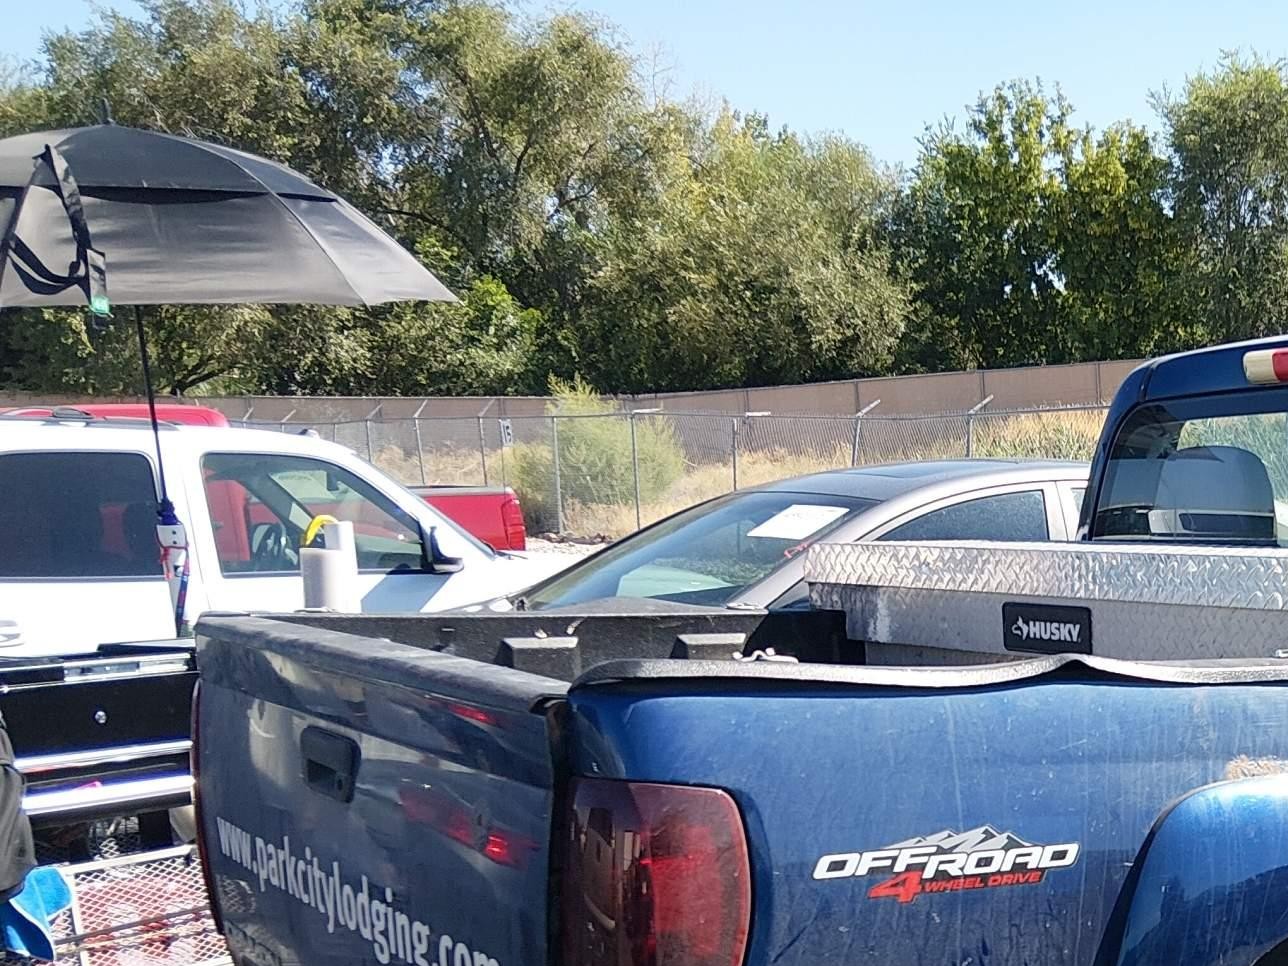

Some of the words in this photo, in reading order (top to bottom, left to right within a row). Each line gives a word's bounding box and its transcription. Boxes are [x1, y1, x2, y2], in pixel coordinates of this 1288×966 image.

[1029, 620, 1080, 643] HUSKY
[867, 870, 922, 905] 4
[924, 875, 984, 893] WHEEL
[988, 870, 1042, 888] DRIVE
